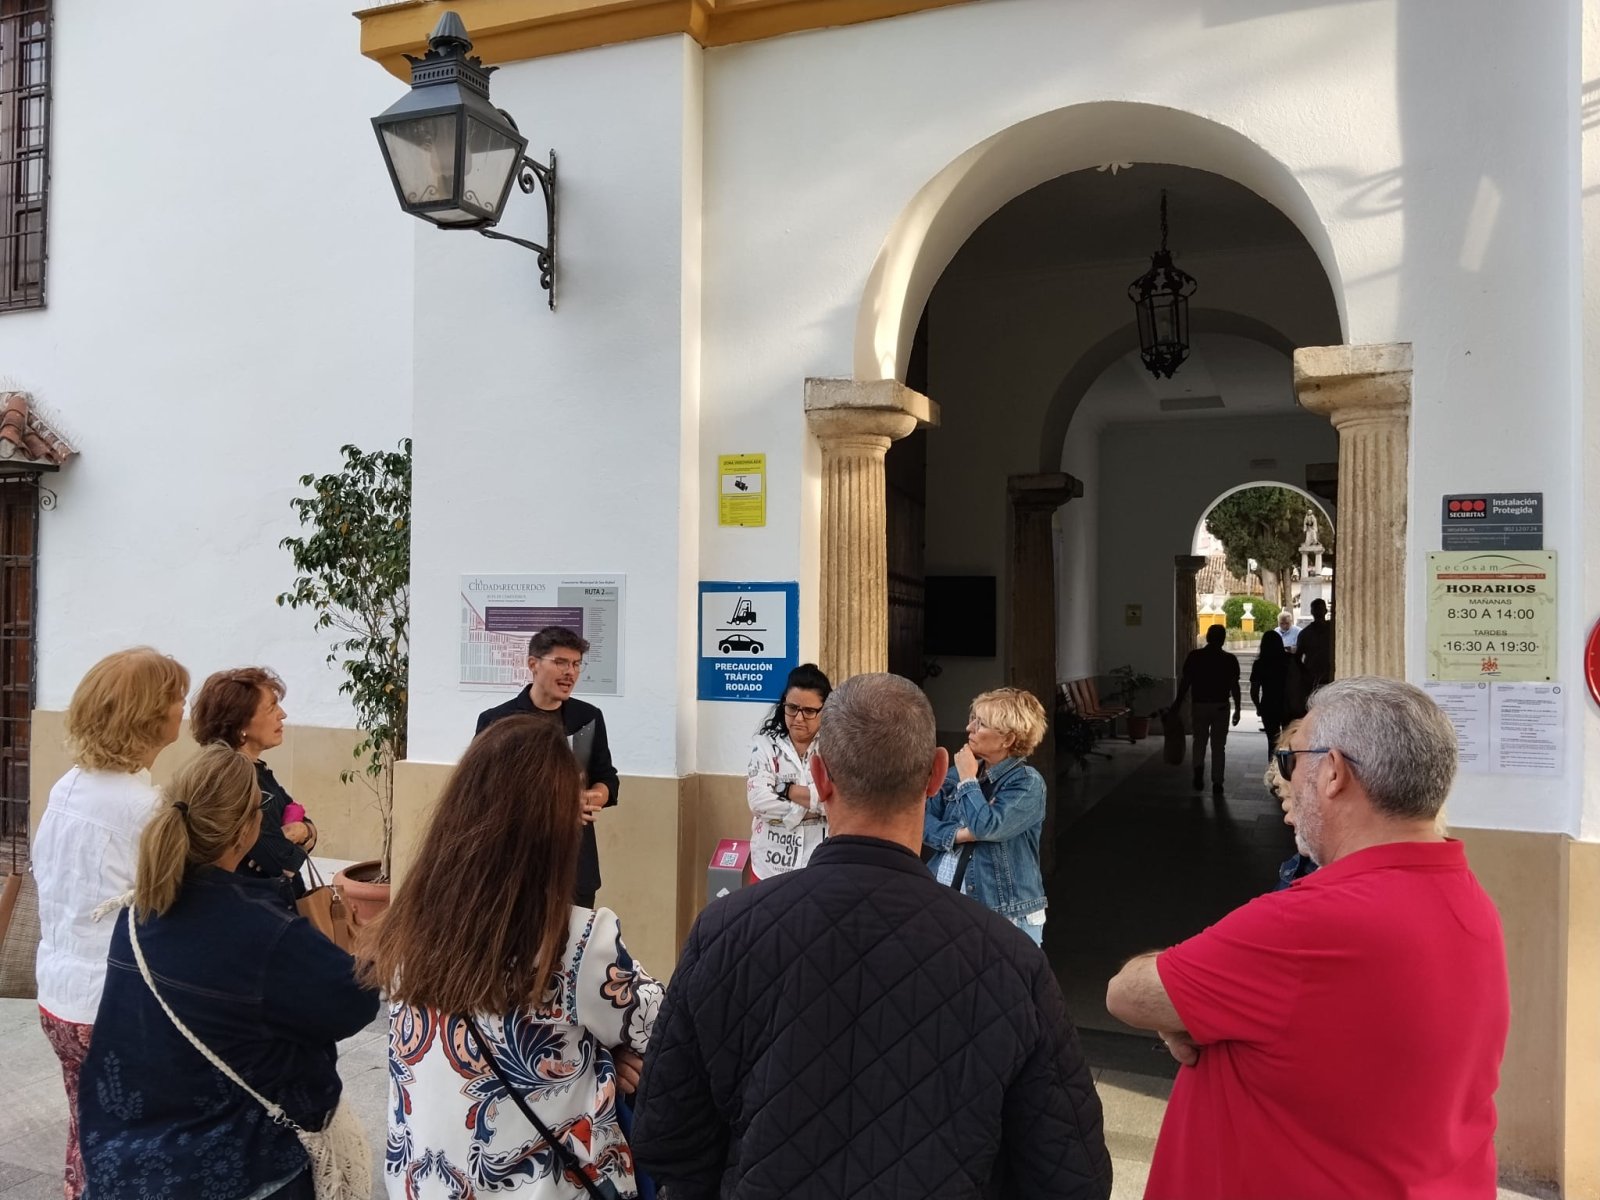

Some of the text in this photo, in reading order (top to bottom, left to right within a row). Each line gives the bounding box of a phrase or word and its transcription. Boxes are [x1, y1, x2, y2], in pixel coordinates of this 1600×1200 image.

[1493, 498, 1538, 506] Instalación
[1493, 506, 1533, 515] Protegida
[1446, 585, 1536, 593] HORARIOS
[1447, 608, 1535, 619] 8:30 A 14:00
[1447, 641, 1536, 652] 16:30 A 19:30
[715, 662, 772, 671] PRECAUCIÓN
[724, 672, 763, 681] TRÁFICO
[732, 842, 738, 851] 1
[767, 830, 803, 855] magic
[765, 846, 799, 868] soul
